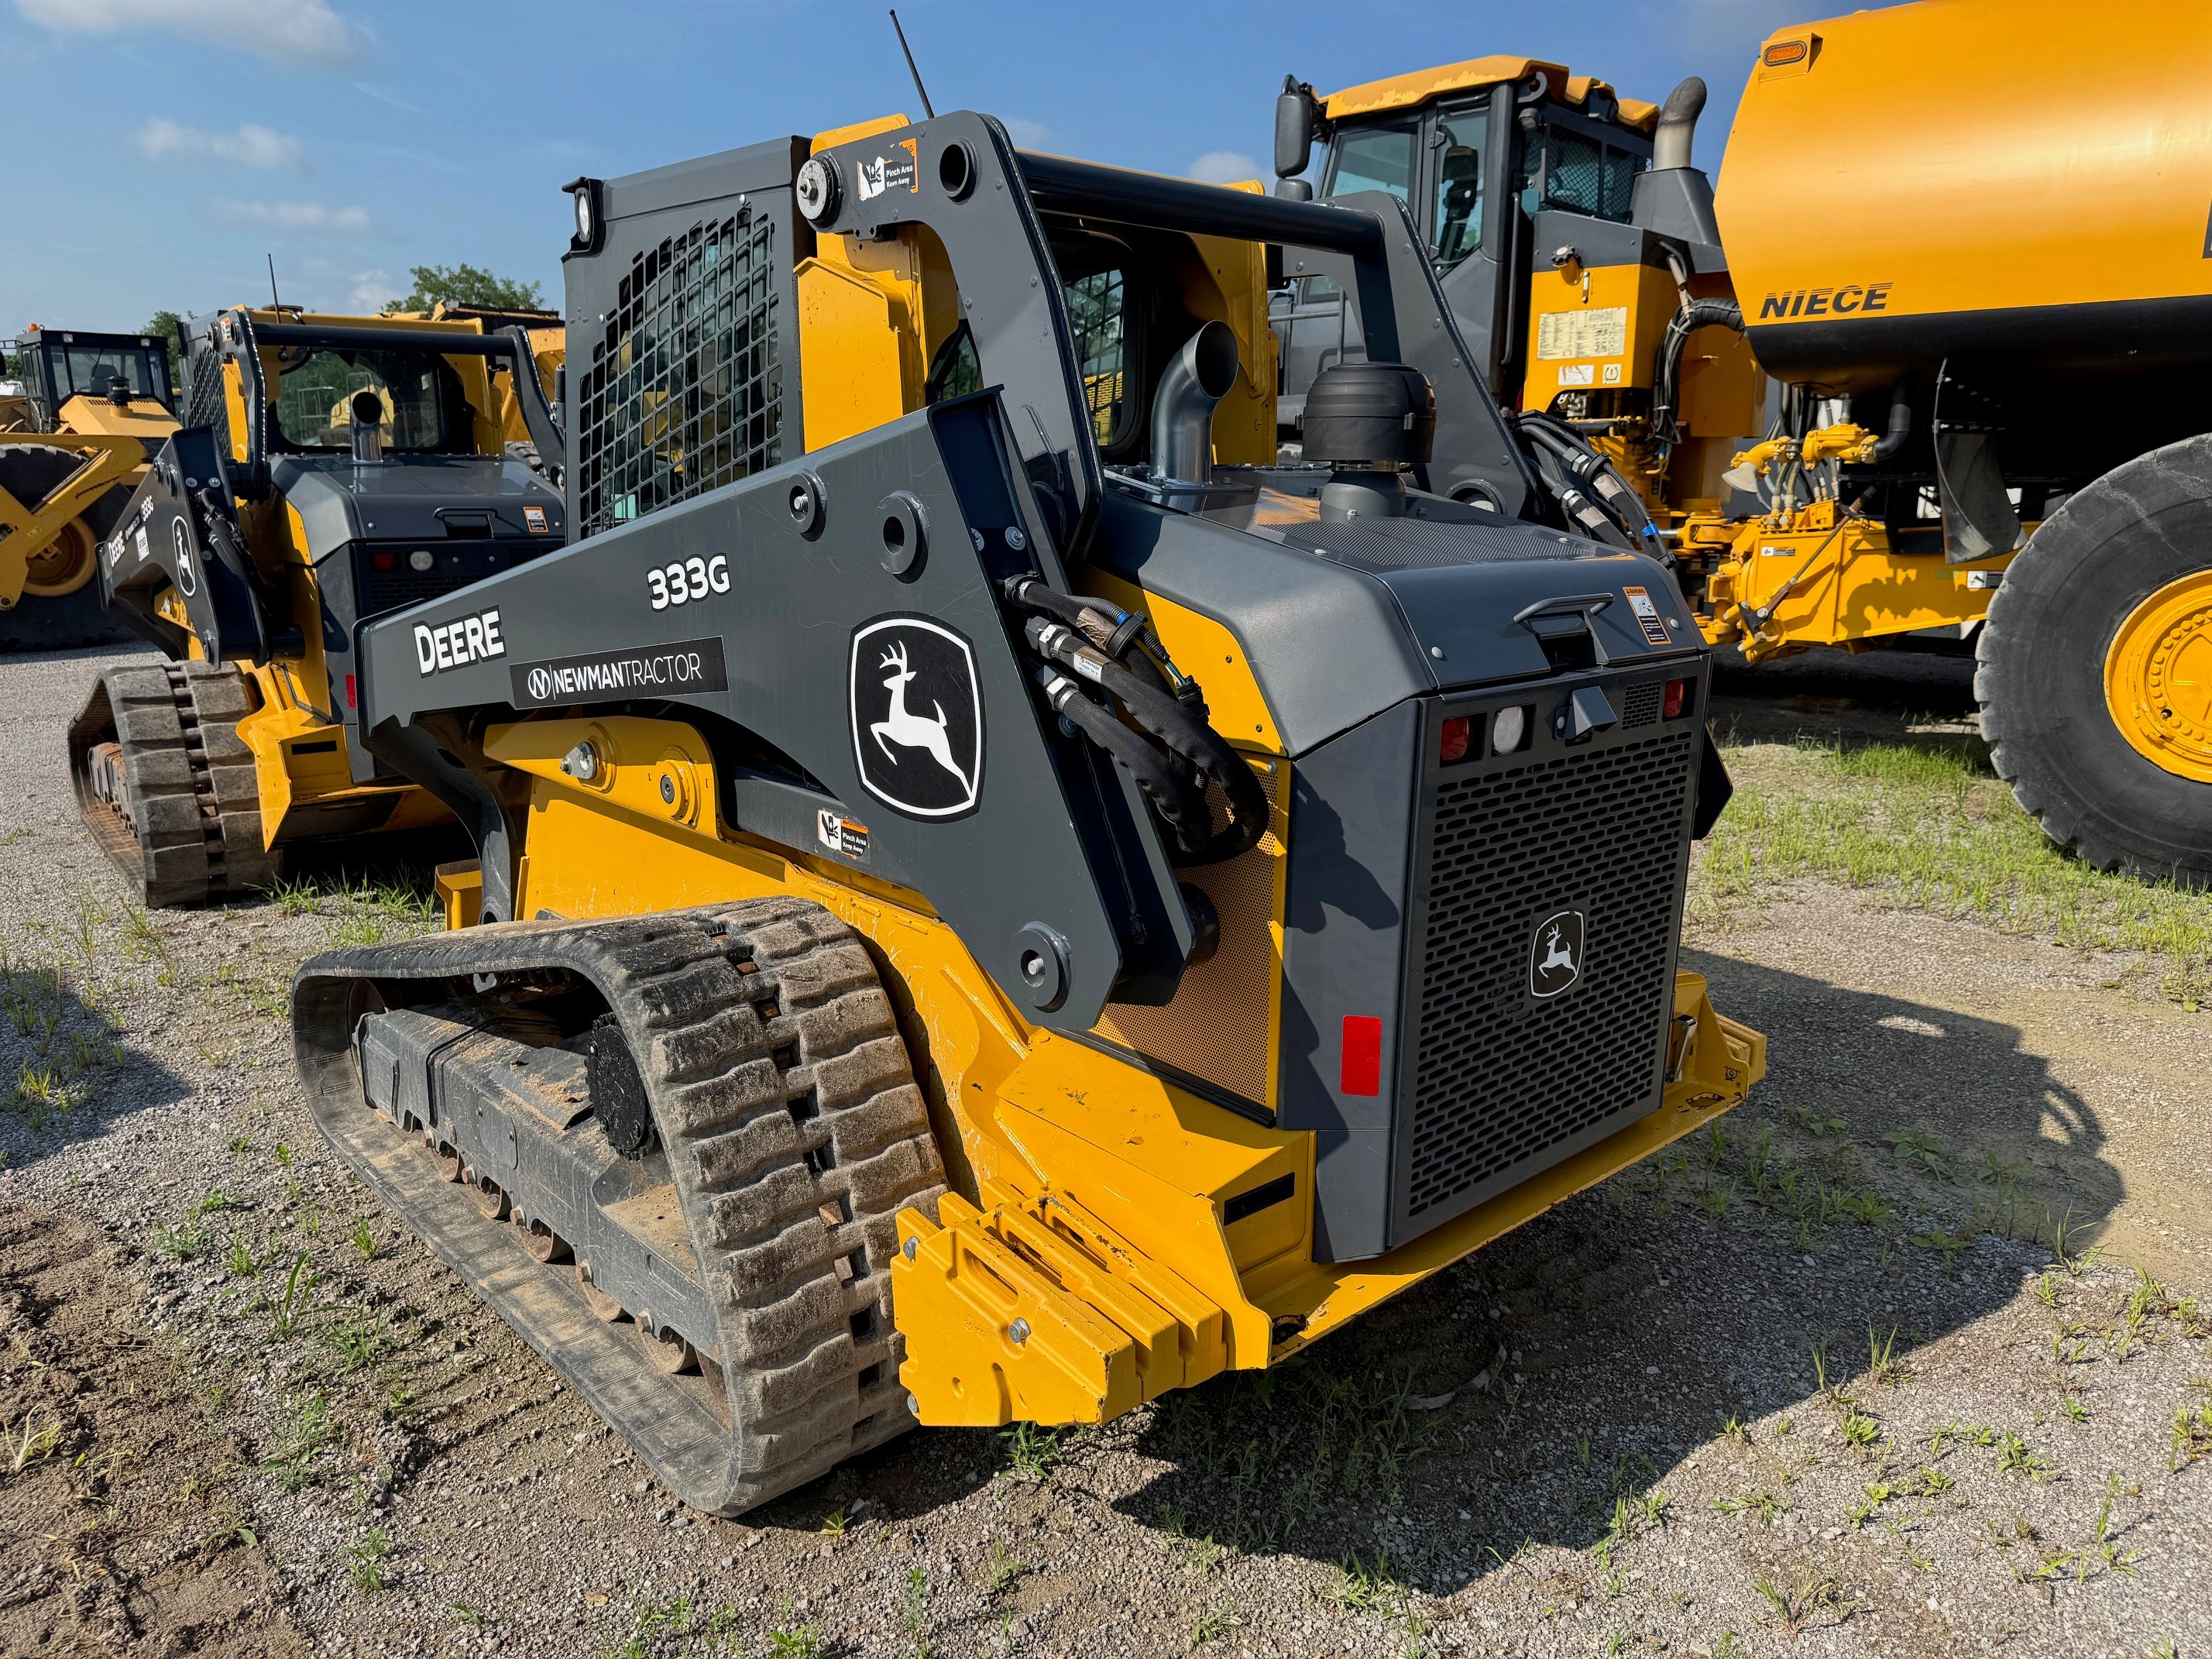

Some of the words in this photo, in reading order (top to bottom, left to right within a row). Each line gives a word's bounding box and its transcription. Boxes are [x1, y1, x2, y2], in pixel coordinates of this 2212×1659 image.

[886, 167, 900, 178] Pinch
[901, 165, 913, 174] Area
[898, 177, 910, 186] Away
[1760, 282, 1894, 319] NIECE
[108, 530, 125, 568] DEERE
[647, 555, 730, 610] 333G
[414, 610, 505, 674] DEERE
[842, 832, 856, 843] Pinch
[855, 836, 867, 846] Area
